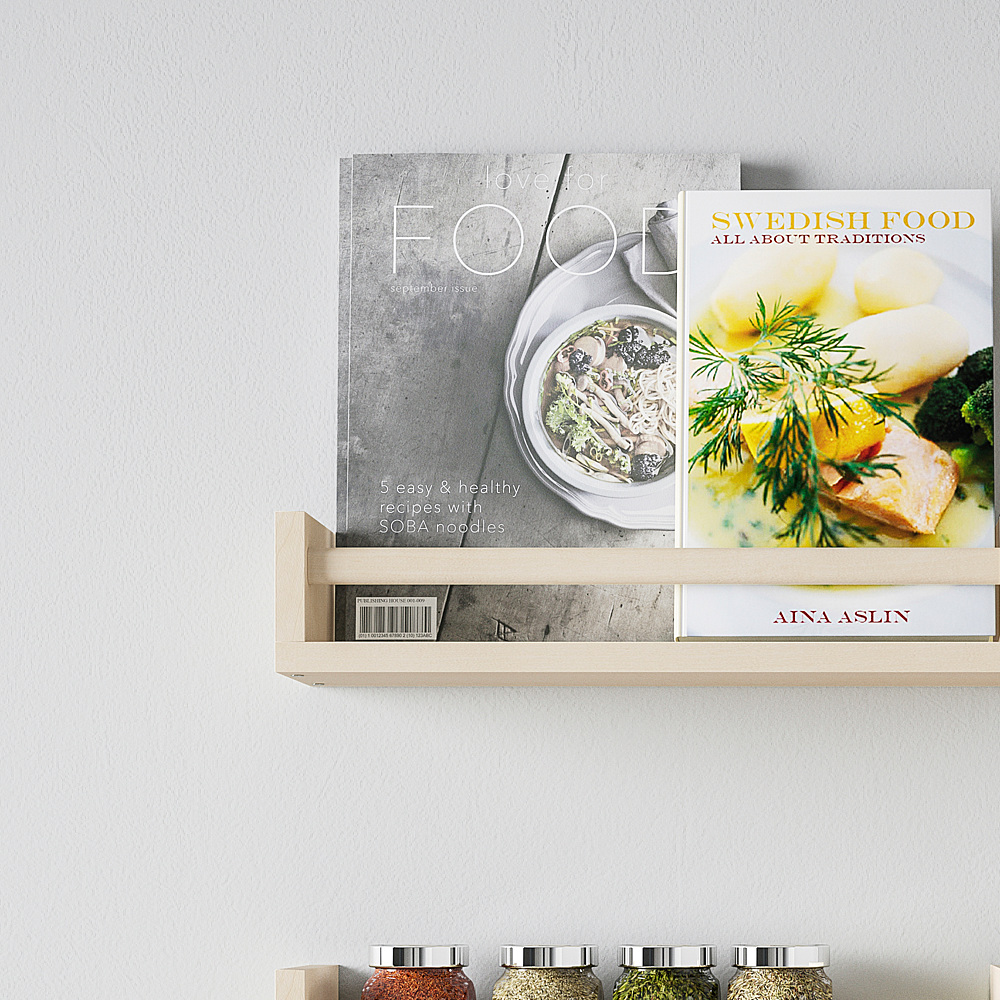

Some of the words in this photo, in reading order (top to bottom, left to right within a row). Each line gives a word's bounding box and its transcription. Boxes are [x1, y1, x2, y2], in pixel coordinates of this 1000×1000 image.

[485, 165, 551, 191] love
[564, 165, 609, 191] for
[711, 211, 871, 231] SWEDISH
[881, 210, 976, 230] FOOD
[710, 233, 746, 245] ALL
[750, 233, 811, 245] ABOUT
[816, 233, 927, 245] TRADITIONS
[389, 283, 448, 296] september
[451, 283, 479, 294] issue
[379, 480, 389, 495] 5
[396, 482, 433, 499] easy
[439, 480, 451, 495] &
[459, 480, 522, 499] healthy
[379, 500, 442, 516] recipes
[447, 500, 483, 515] with
[379, 519, 430, 534] SOBA
[435, 519, 506, 535] noodles
[773, 610, 832, 624] AINA
[838, 610, 911, 624] ASLIN
